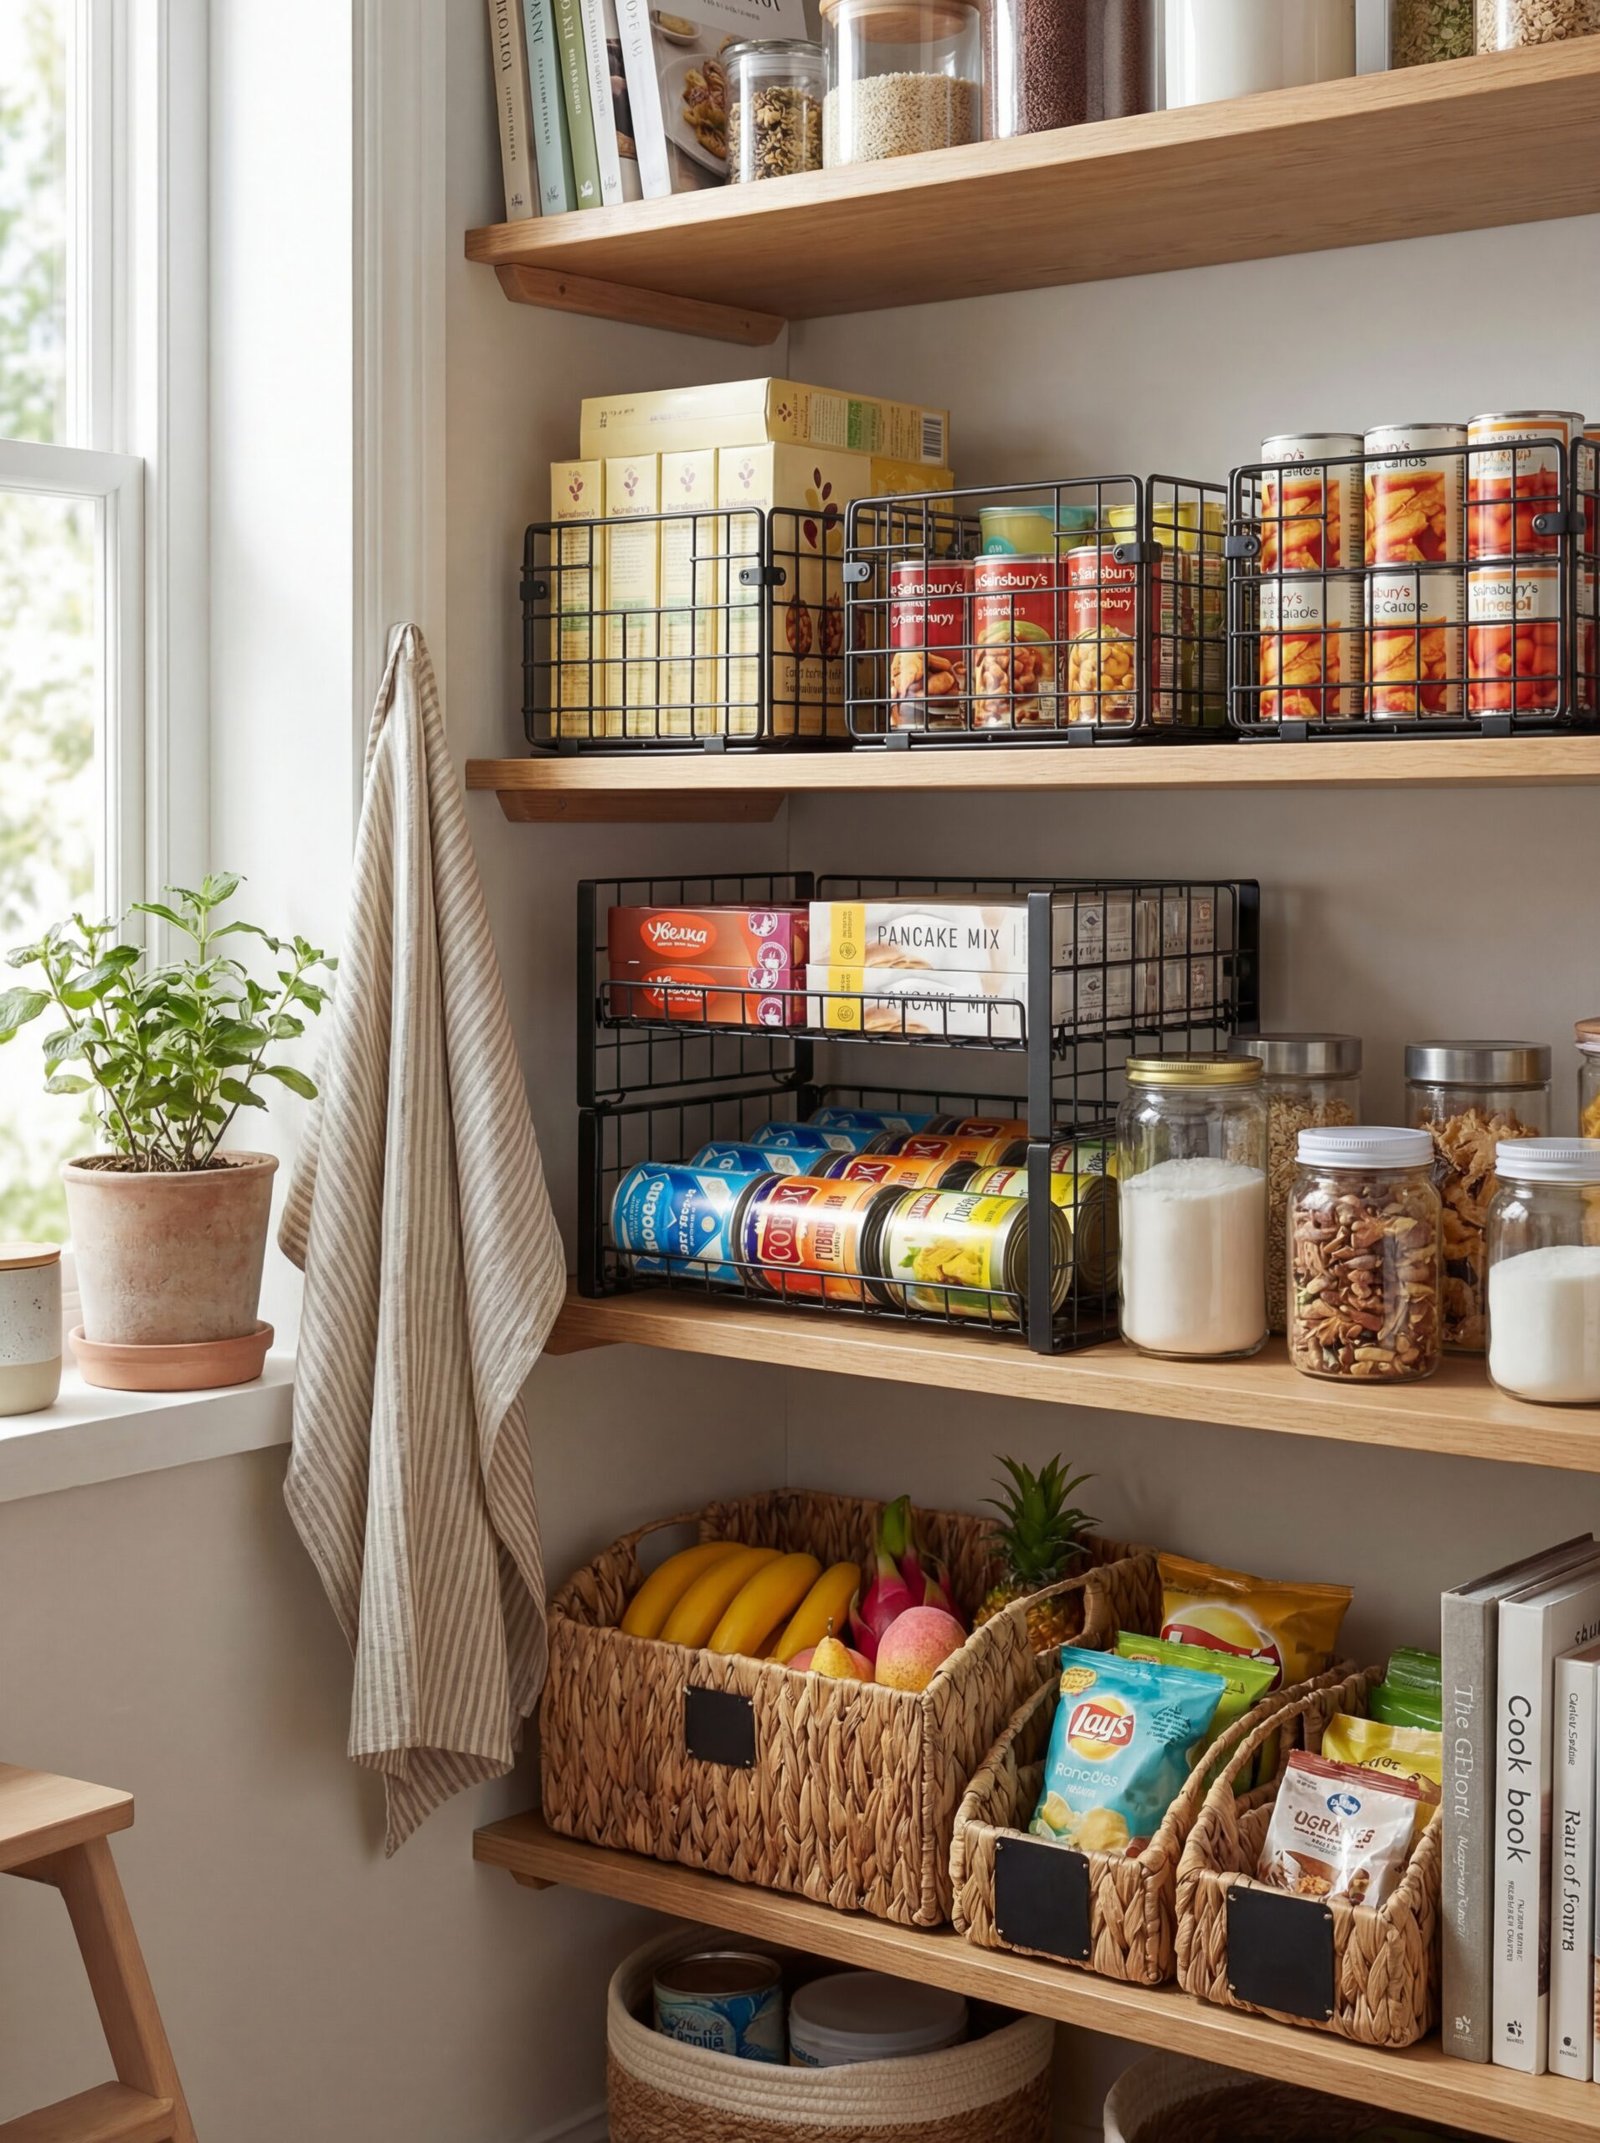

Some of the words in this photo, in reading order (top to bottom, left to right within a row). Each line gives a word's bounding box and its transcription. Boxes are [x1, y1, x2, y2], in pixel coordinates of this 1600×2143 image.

[877, 925, 958, 949] PANCAKE
[967, 928, 1000, 950] MIX
[967, 994, 999, 1014] MIX
[1507, 1695, 1532, 1774] Cook
[1506, 1788, 1531, 1864] book
[1563, 1864, 1581, 1886] of
